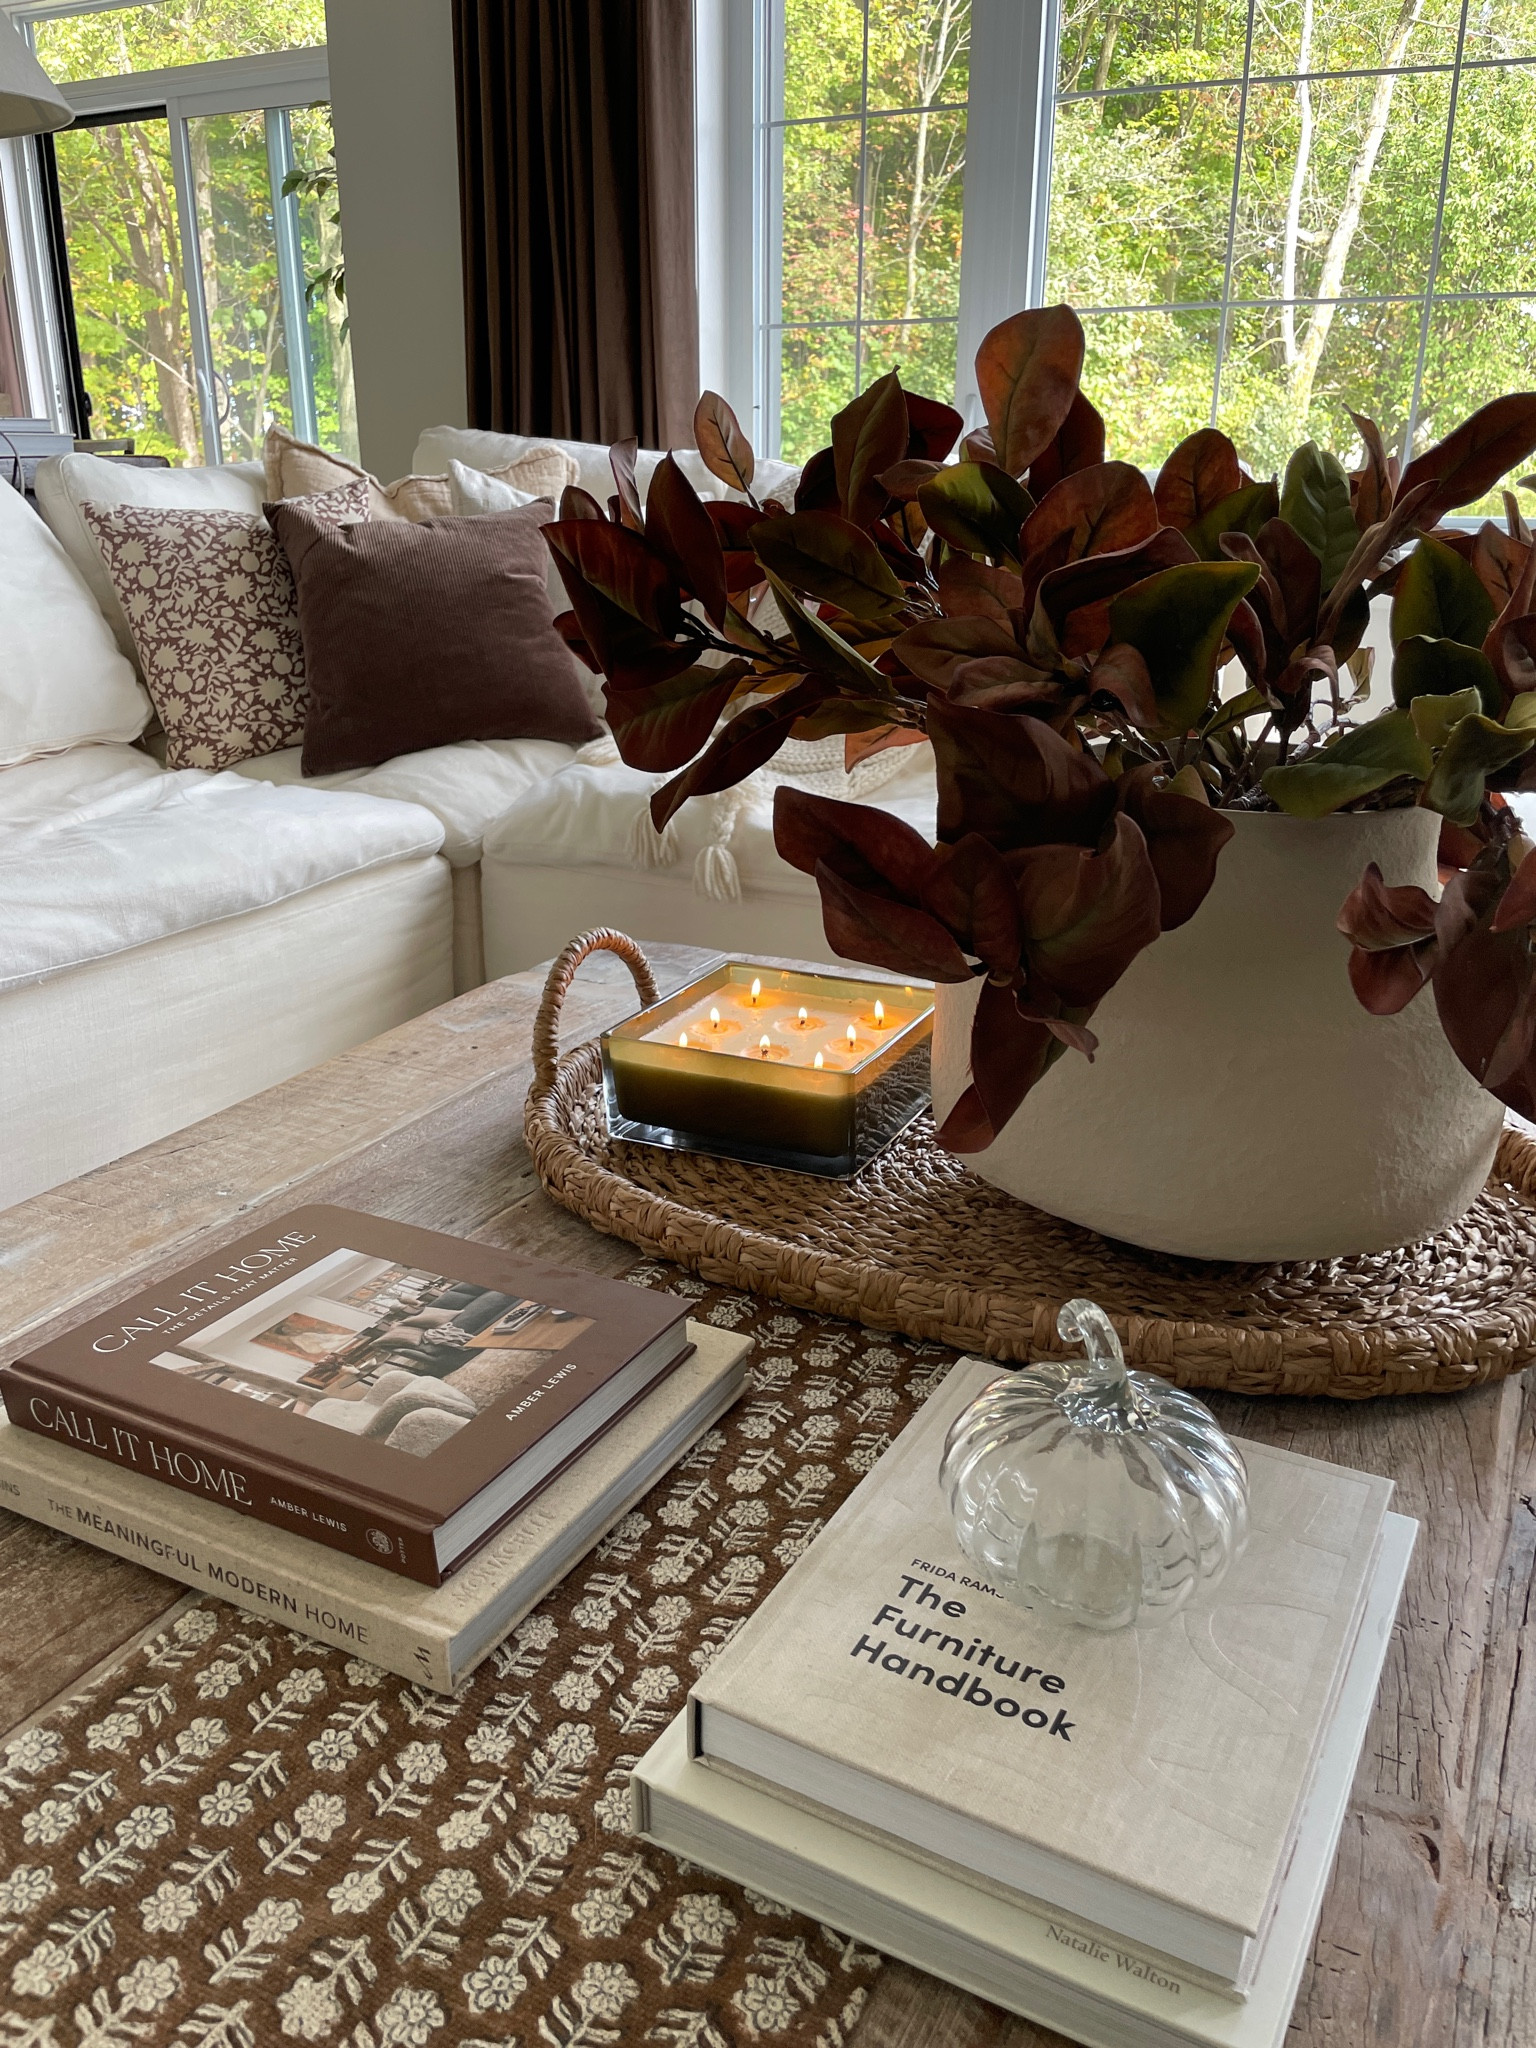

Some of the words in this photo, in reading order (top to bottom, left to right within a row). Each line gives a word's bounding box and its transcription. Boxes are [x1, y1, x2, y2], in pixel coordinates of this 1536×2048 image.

[92, 1306, 189, 1353] CALL
[179, 1281, 218, 1303] IT
[214, 1231, 317, 1283] HOME
[162, 1320, 186, 1335] THE
[187, 1295, 231, 1321] DETAILS
[231, 1279, 258, 1295] THAT
[258, 1257, 299, 1280] MATTER
[505, 1390, 545, 1421] AMBER
[541, 1363, 577, 1389] LEWIS
[30, 1397, 108, 1450] CALL
[111, 1426, 140, 1462] IT
[148, 1440, 253, 1506] HOME
[270, 1496, 309, 1518] AMBER
[312, 1512, 348, 1533] LEWIS
[47, 1498, 73, 1519] THE
[76, 1507, 202, 1573] MEANINGFUL
[208, 1562, 298, 1614] MODERN
[305, 1603, 370, 1645] HOME
[898, 1574, 967, 1618] The
[911, 1558, 956, 1582] FRIDA
[850, 1633, 1077, 1742] Handbook
[872, 1603, 1066, 1694] Furniture
[1046, 1924, 1110, 1963] Natalie
[1116, 1953, 1182, 1994] Walton
